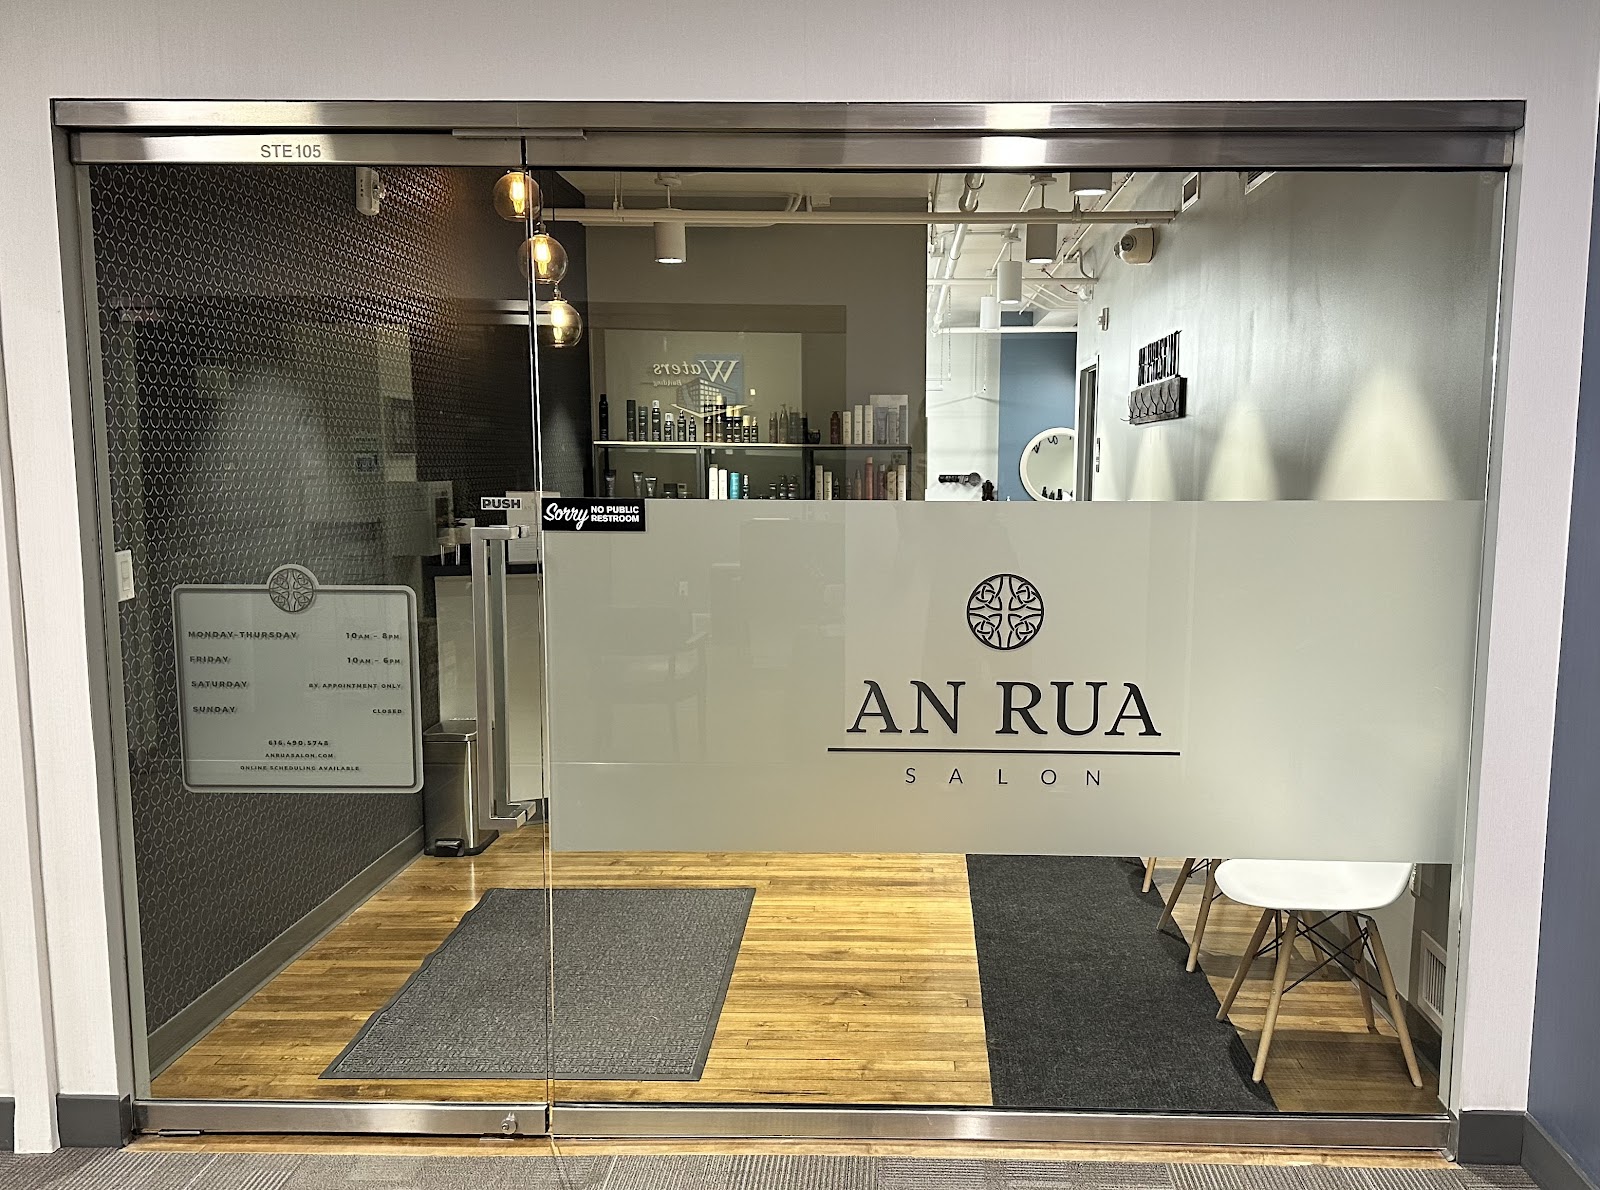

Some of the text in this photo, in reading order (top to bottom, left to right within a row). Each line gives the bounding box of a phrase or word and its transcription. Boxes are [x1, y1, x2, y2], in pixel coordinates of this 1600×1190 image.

[260, 144, 321, 158] STE 105
[482, 498, 521, 509] PUSH
[590, 506, 639, 514] NO PUBLIC
[543, 502, 590, 531] Sorry
[590, 514, 640, 523] RESTROOM
[188, 631, 297, 639] MONDAY-THURSDAY
[846, 680, 1162, 737] AN RUA
[904, 767, 1100, 786] SALON
